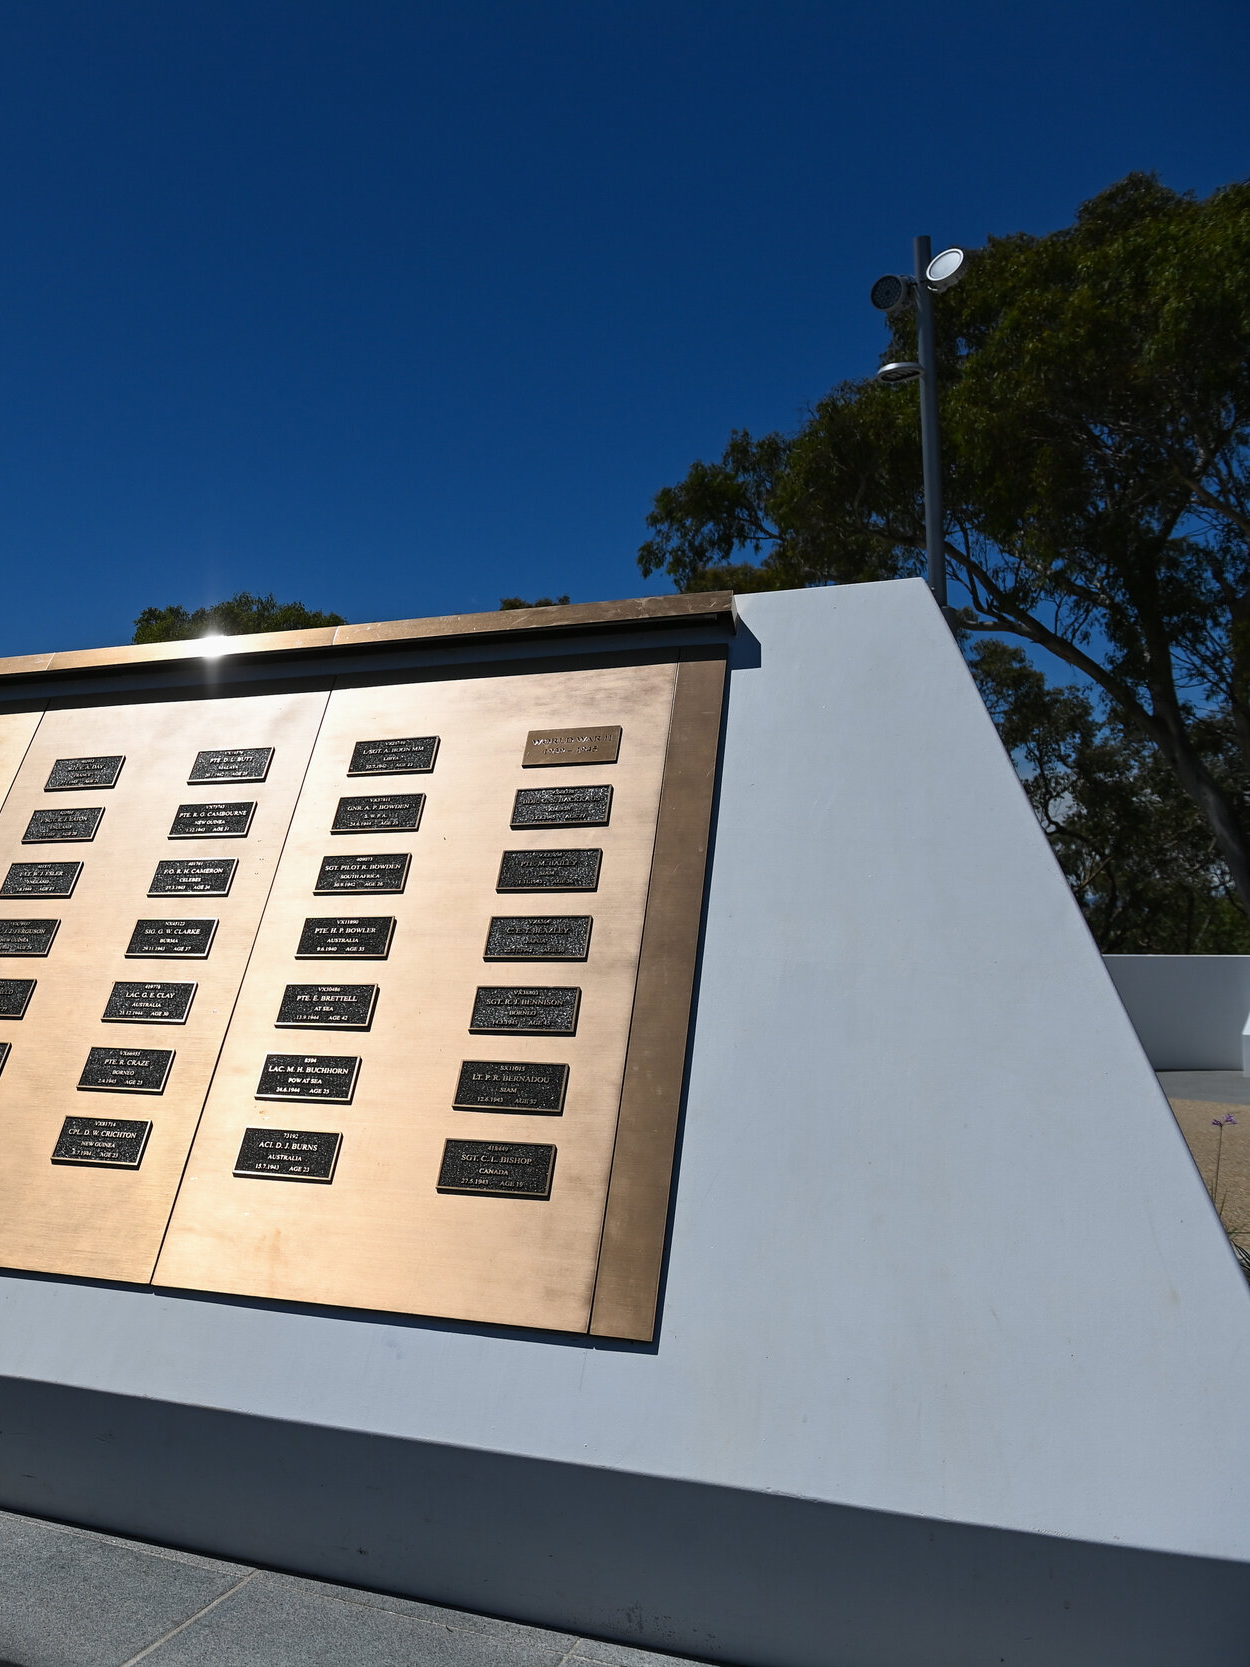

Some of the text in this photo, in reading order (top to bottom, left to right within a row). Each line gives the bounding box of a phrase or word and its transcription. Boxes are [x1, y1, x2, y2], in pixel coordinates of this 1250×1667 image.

[532, 737, 574, 746] WORLD
[576, 735, 601, 743] WAR
[502, 1075, 550, 1083] BERNADOU
[100, 1130, 137, 1139] CRICHTON
[291, 1143, 318, 1151] BURNS
[500, 1156, 533, 1165] BISHOP
